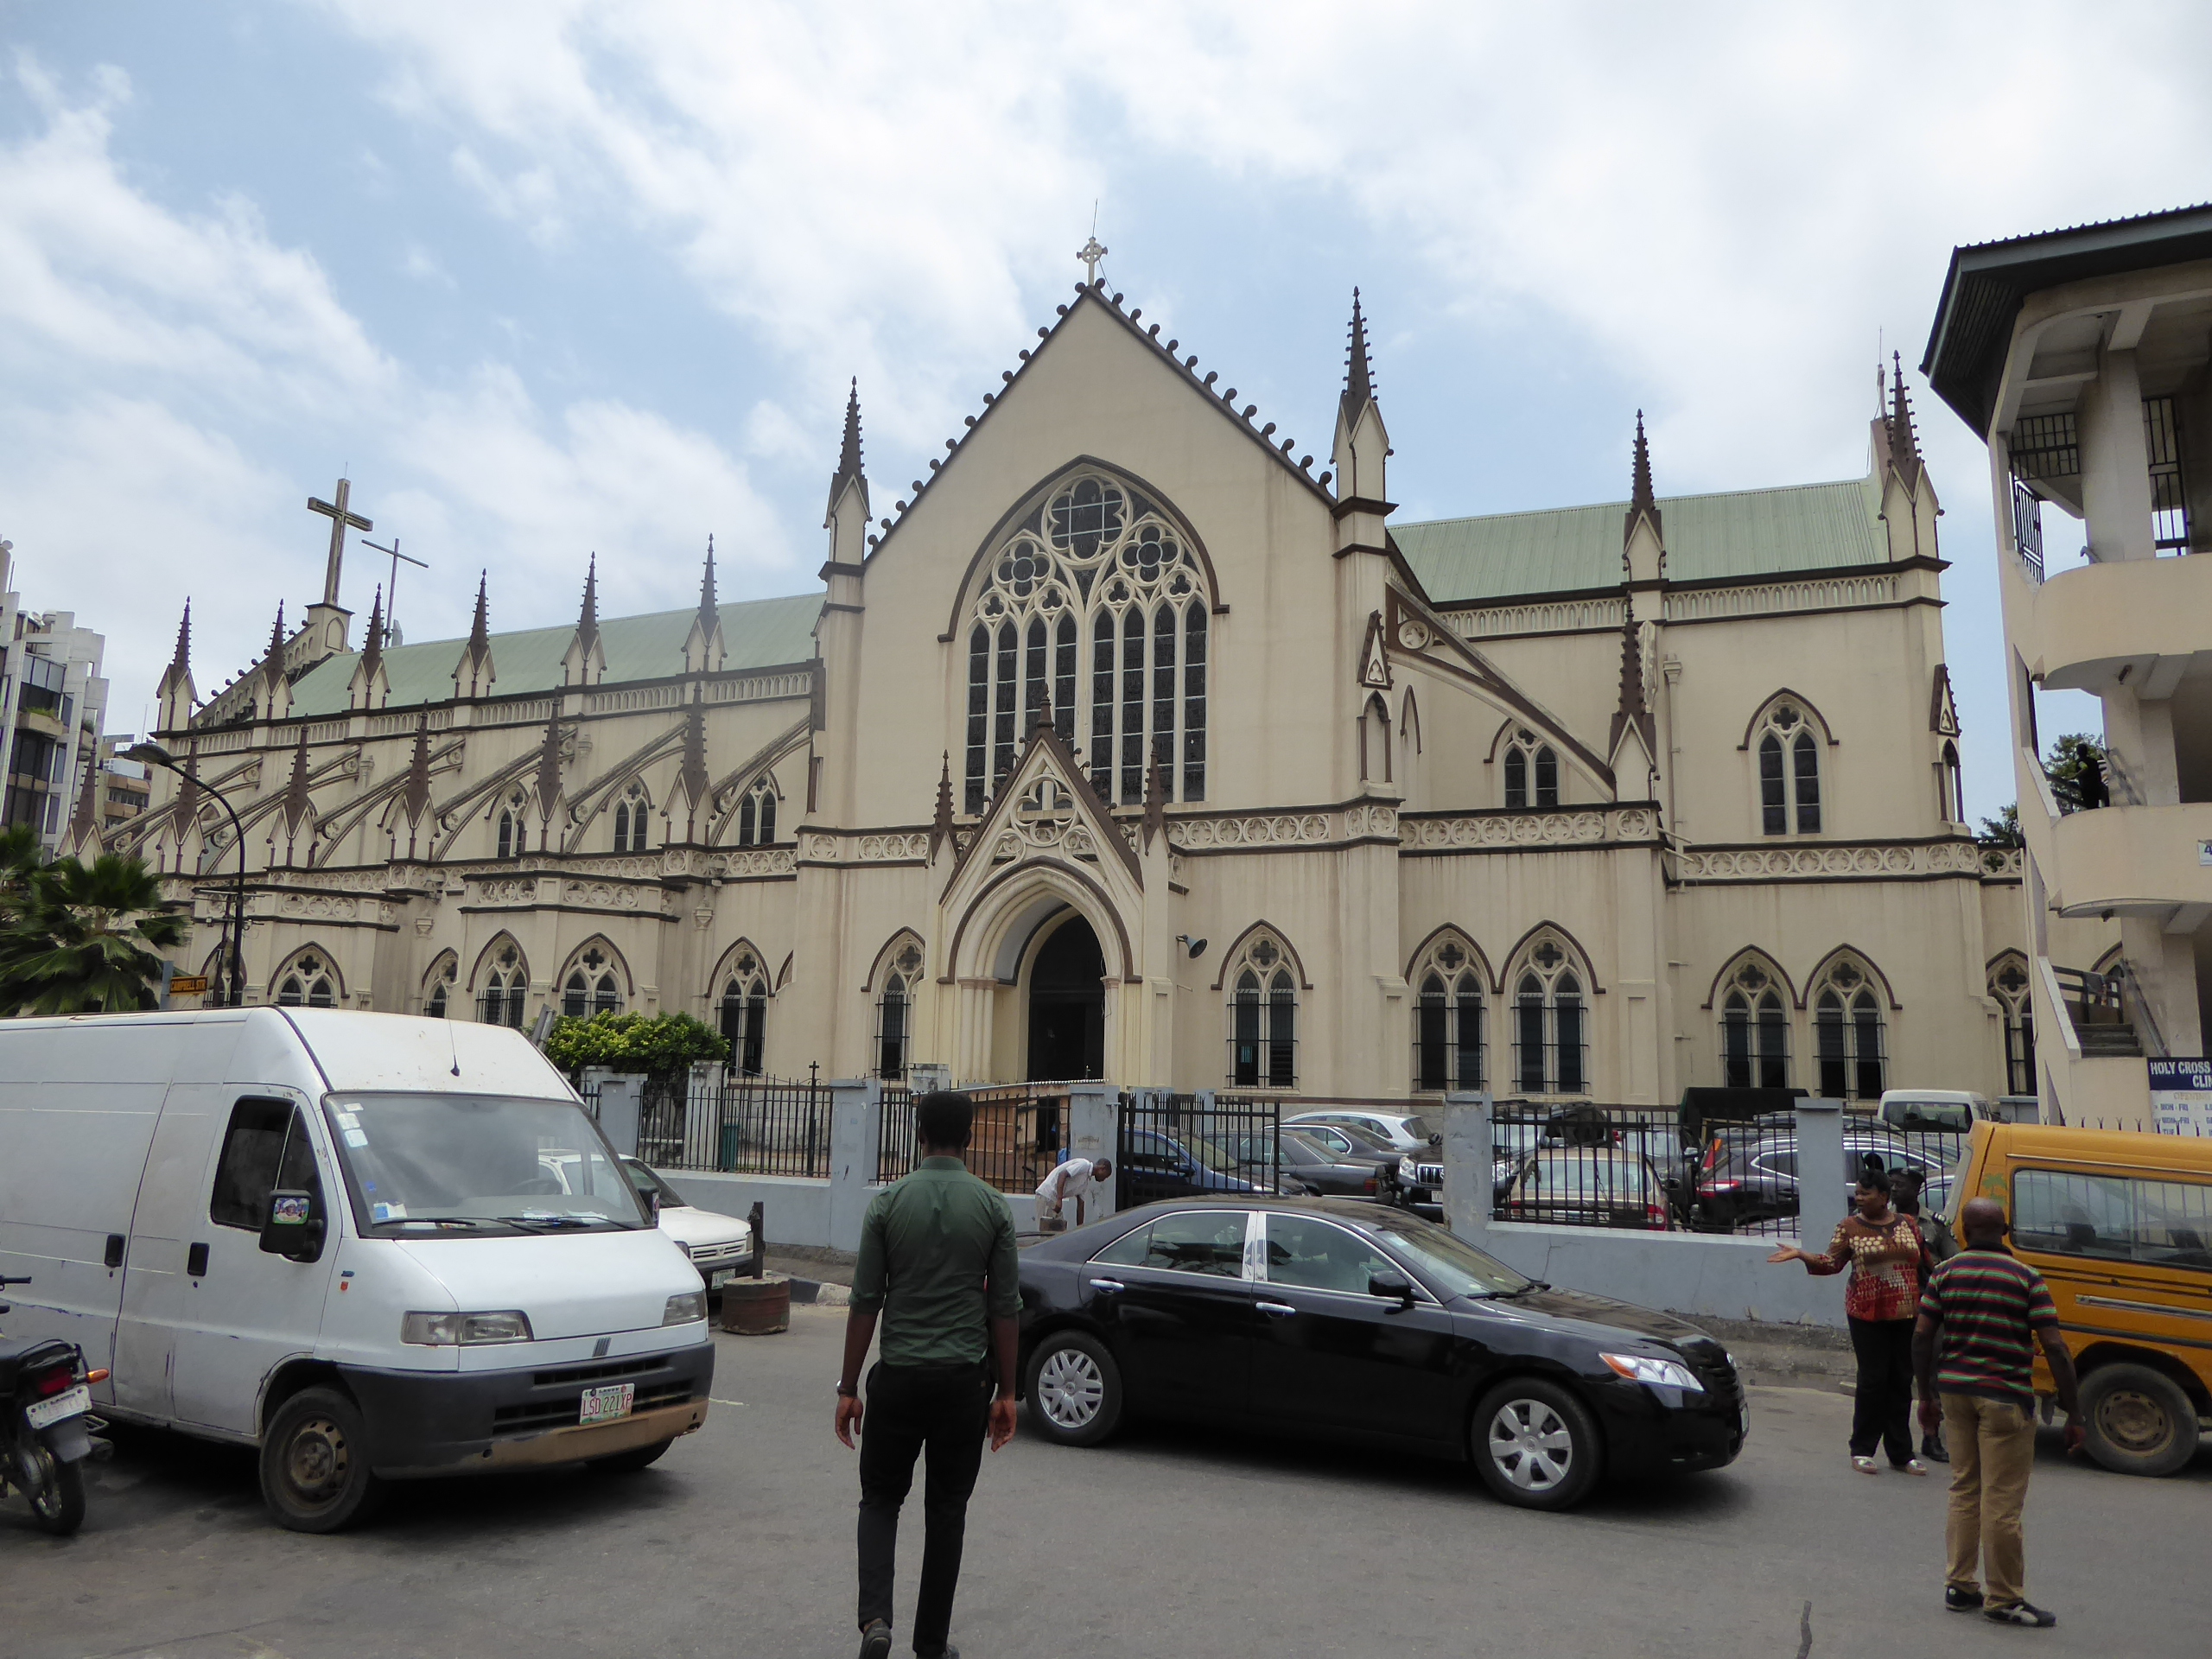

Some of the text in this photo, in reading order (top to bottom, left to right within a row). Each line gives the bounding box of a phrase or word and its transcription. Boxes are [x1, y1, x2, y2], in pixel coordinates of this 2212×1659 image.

[171, 980, 194, 992] CAMPBELL
[2150, 1061, 2210, 1075] HOLY CROSS
[582, 1393, 632, 1416] LSD 221XP
